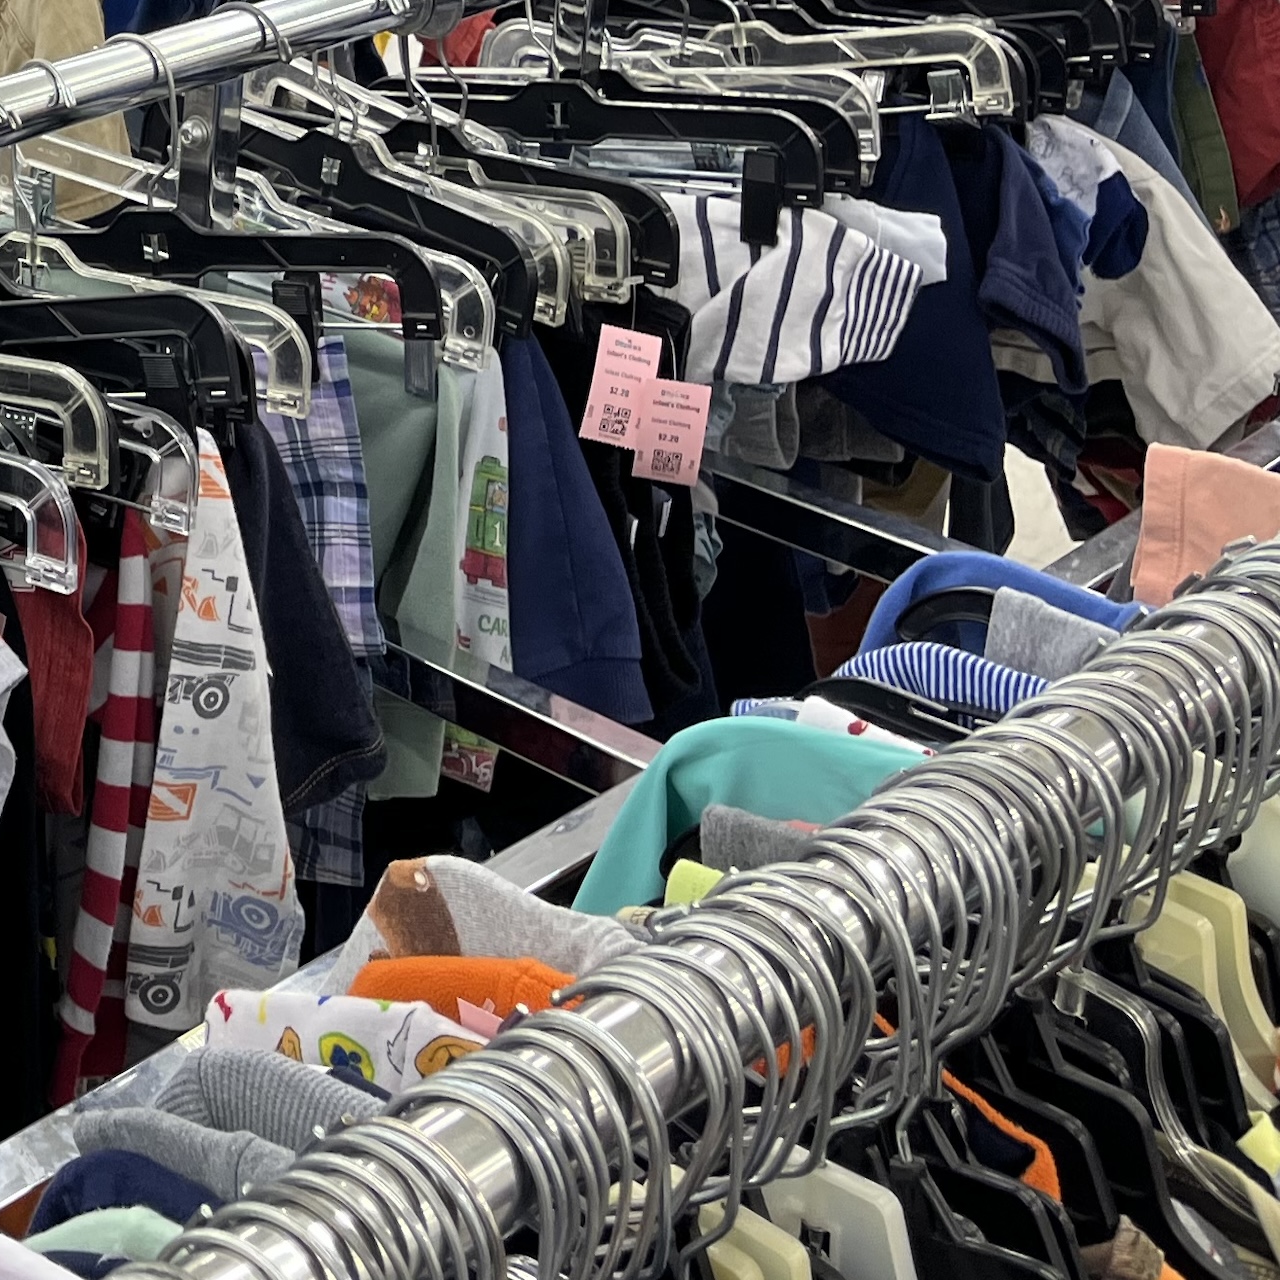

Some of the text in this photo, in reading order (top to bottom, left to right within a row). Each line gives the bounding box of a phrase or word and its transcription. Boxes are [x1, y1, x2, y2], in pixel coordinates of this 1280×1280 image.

[628, 354, 651, 367] Clothing
[620, 370, 642, 384] Clothing
[609, 386, 630, 399] $2.20
[675, 403, 701, 414] Clothing
[668, 419, 691, 431] Clothing
[657, 432, 680, 444] $2.20
[493, 520, 502, 547] 1
